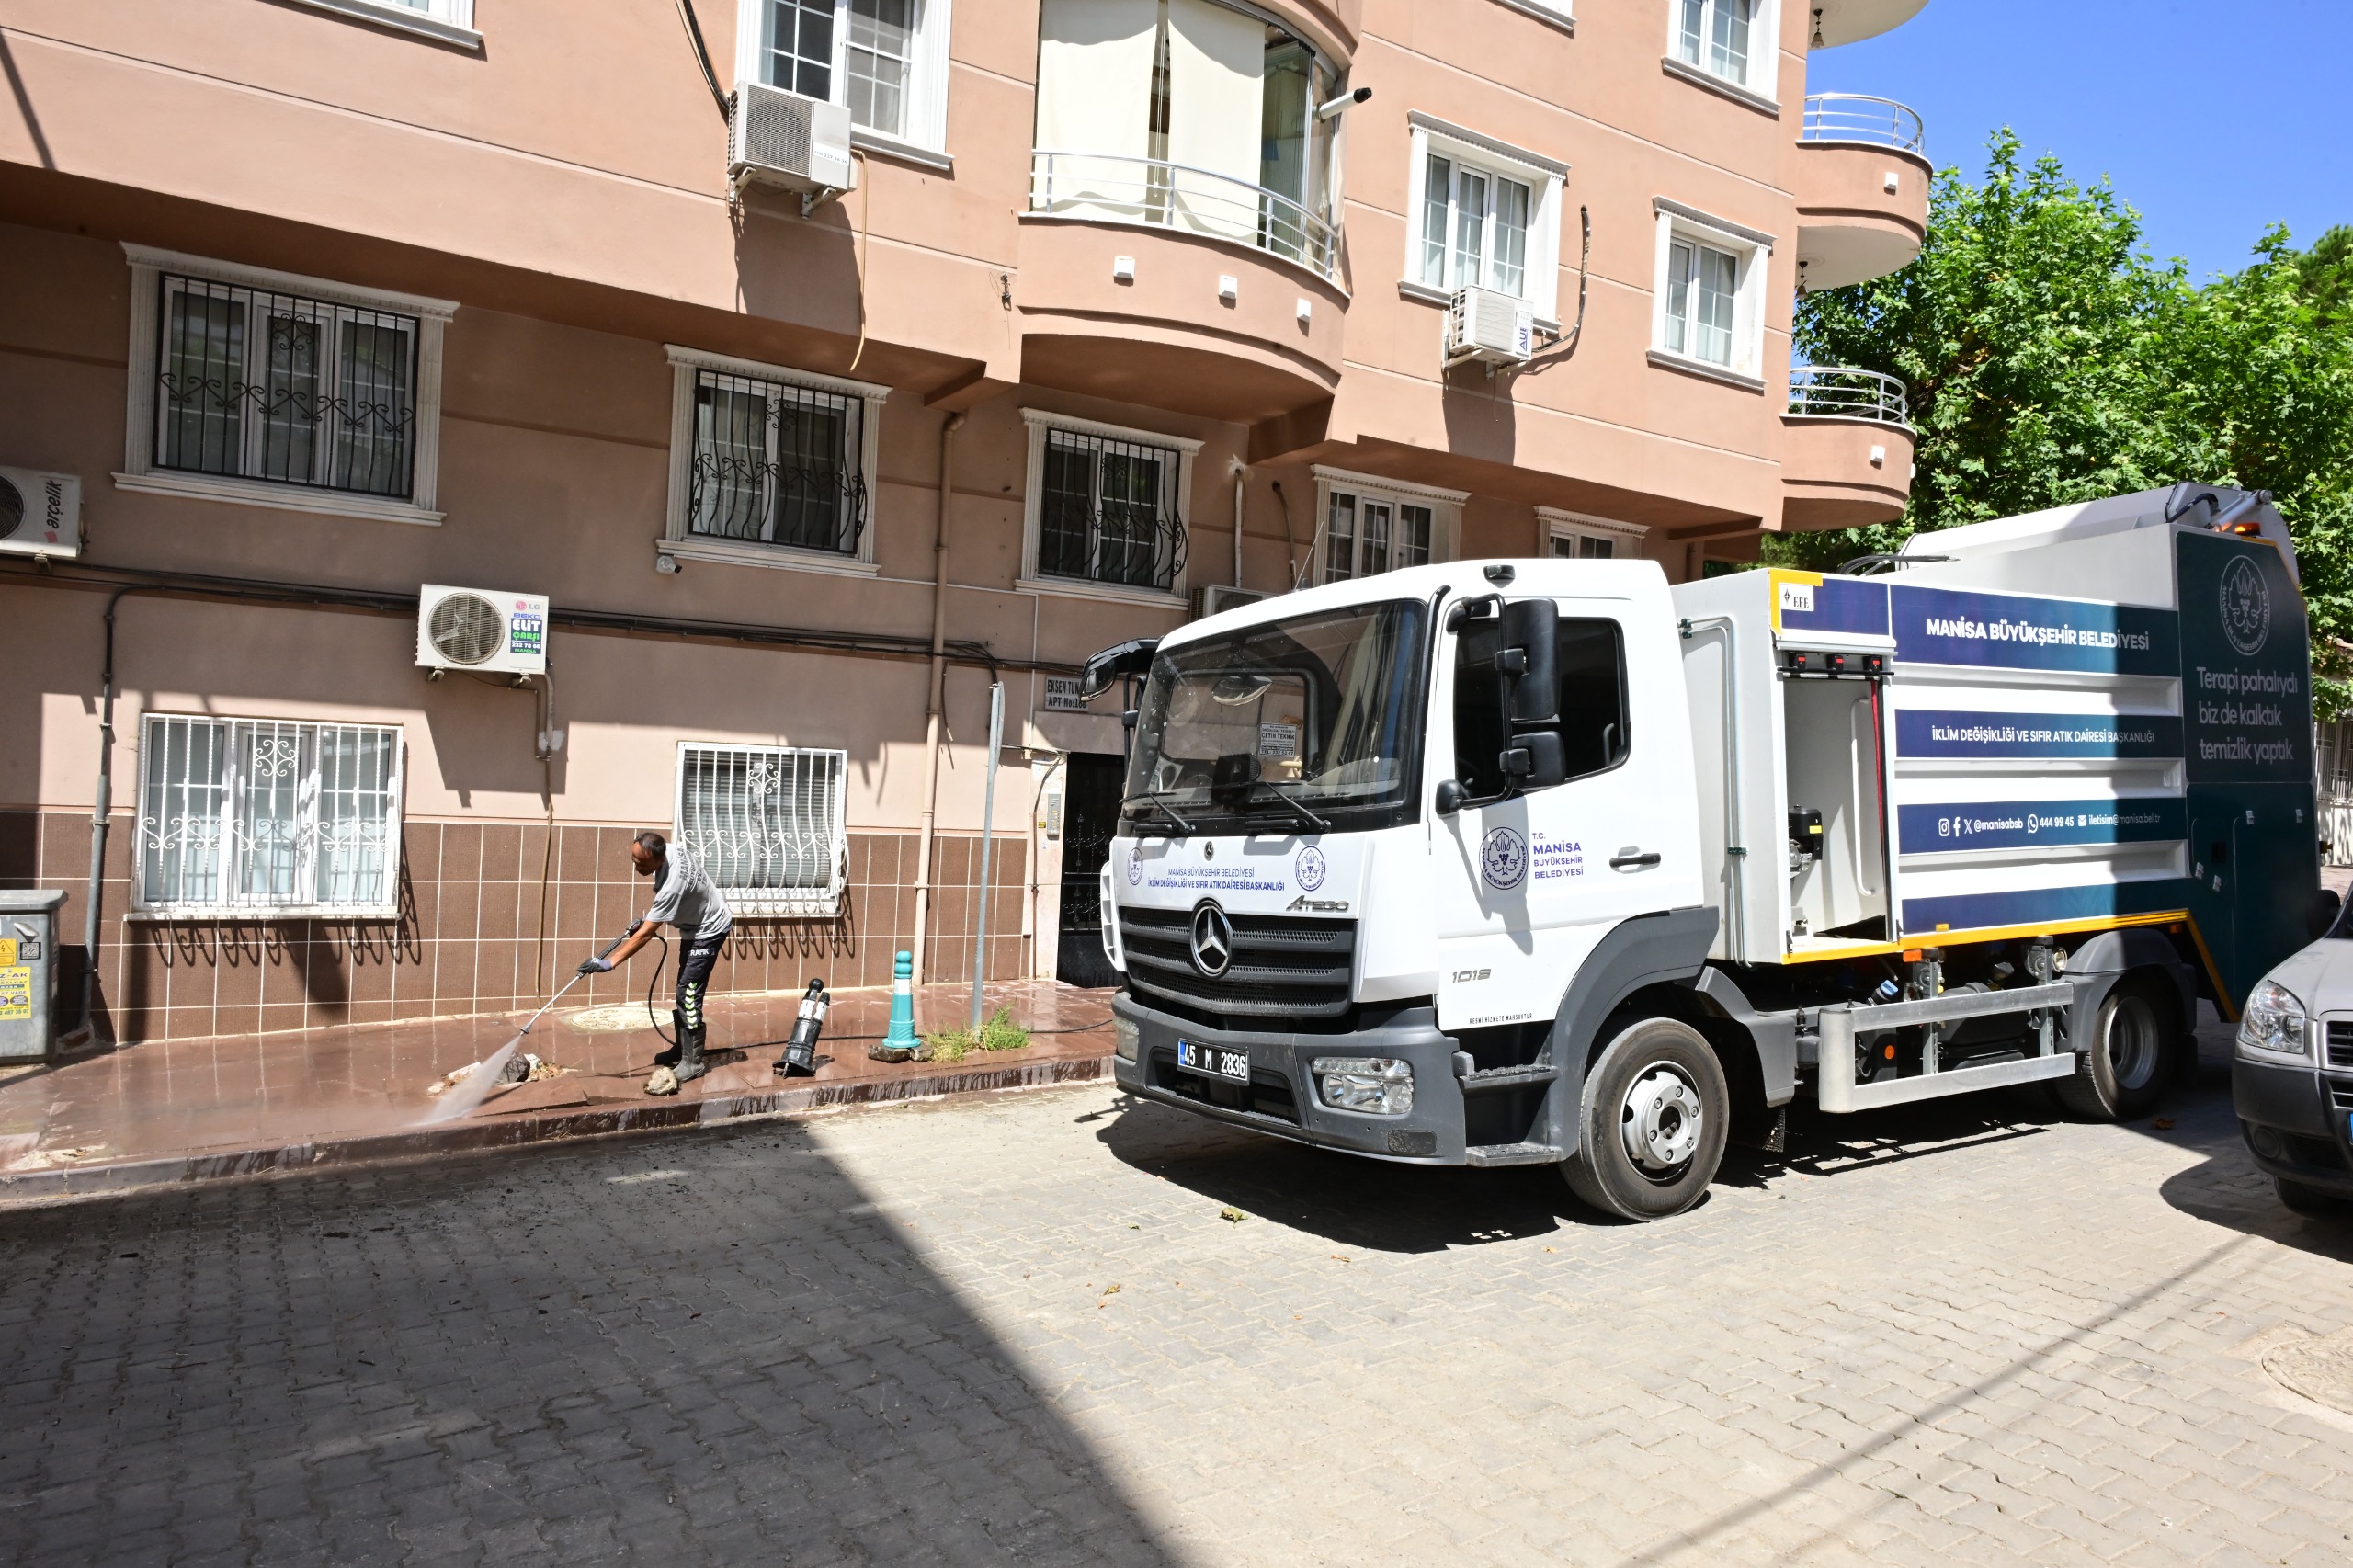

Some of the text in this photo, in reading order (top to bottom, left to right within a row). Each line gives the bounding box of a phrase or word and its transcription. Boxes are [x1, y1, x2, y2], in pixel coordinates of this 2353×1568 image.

[45, 480, 63, 529] arçelik
[1794, 596, 1809, 608] EFE
[513, 632, 540, 642] ÇARŞI
[1927, 616, 2149, 650] MANİSA BÜYÜKŞEHİR BELEDİYESİ
[1048, 679, 1066, 694] EKSEN
[2196, 666, 2298, 698] Terapi pahalıydı
[1048, 696, 1062, 706] APT
[2199, 701, 2282, 726] biz de kalktık
[1932, 725, 2155, 744] İKLİM DEĞİŞİKLİĞİ VE SIFIR ATIK DAİRESİ BAŞKANLIĞI
[2199, 737, 2295, 765] temizlik yaptık
[1974, 812, 2161, 832] @manisabsb 444 99 45 iletisim@manisa.bel.tr
[1533, 840, 1581, 855] MANİSA
[1534, 855, 1583, 867] BÜYÜKŞEHİR
[1168, 865, 1254, 879] MANİSA BÜYÜKŞEHİR BELEDİYESİ
[1535, 866, 1583, 879] BELEDİYESİ
[1148, 877, 1284, 892] İKLİM DEĞİŞİKLİĞİ VE SIFIR ATIK DAİRESİ BAŞKANLIĞI
[1286, 895, 1349, 912] ATEGO
[1453, 969, 1491, 983] 1018
[1470, 1013, 1532, 1024] RESMİ HİZMETE MAHSUSTUR
[1184, 1044, 1196, 1066] 45
[1205, 1049, 1212, 1070] M
[1221, 1052, 1246, 1077] 2836
